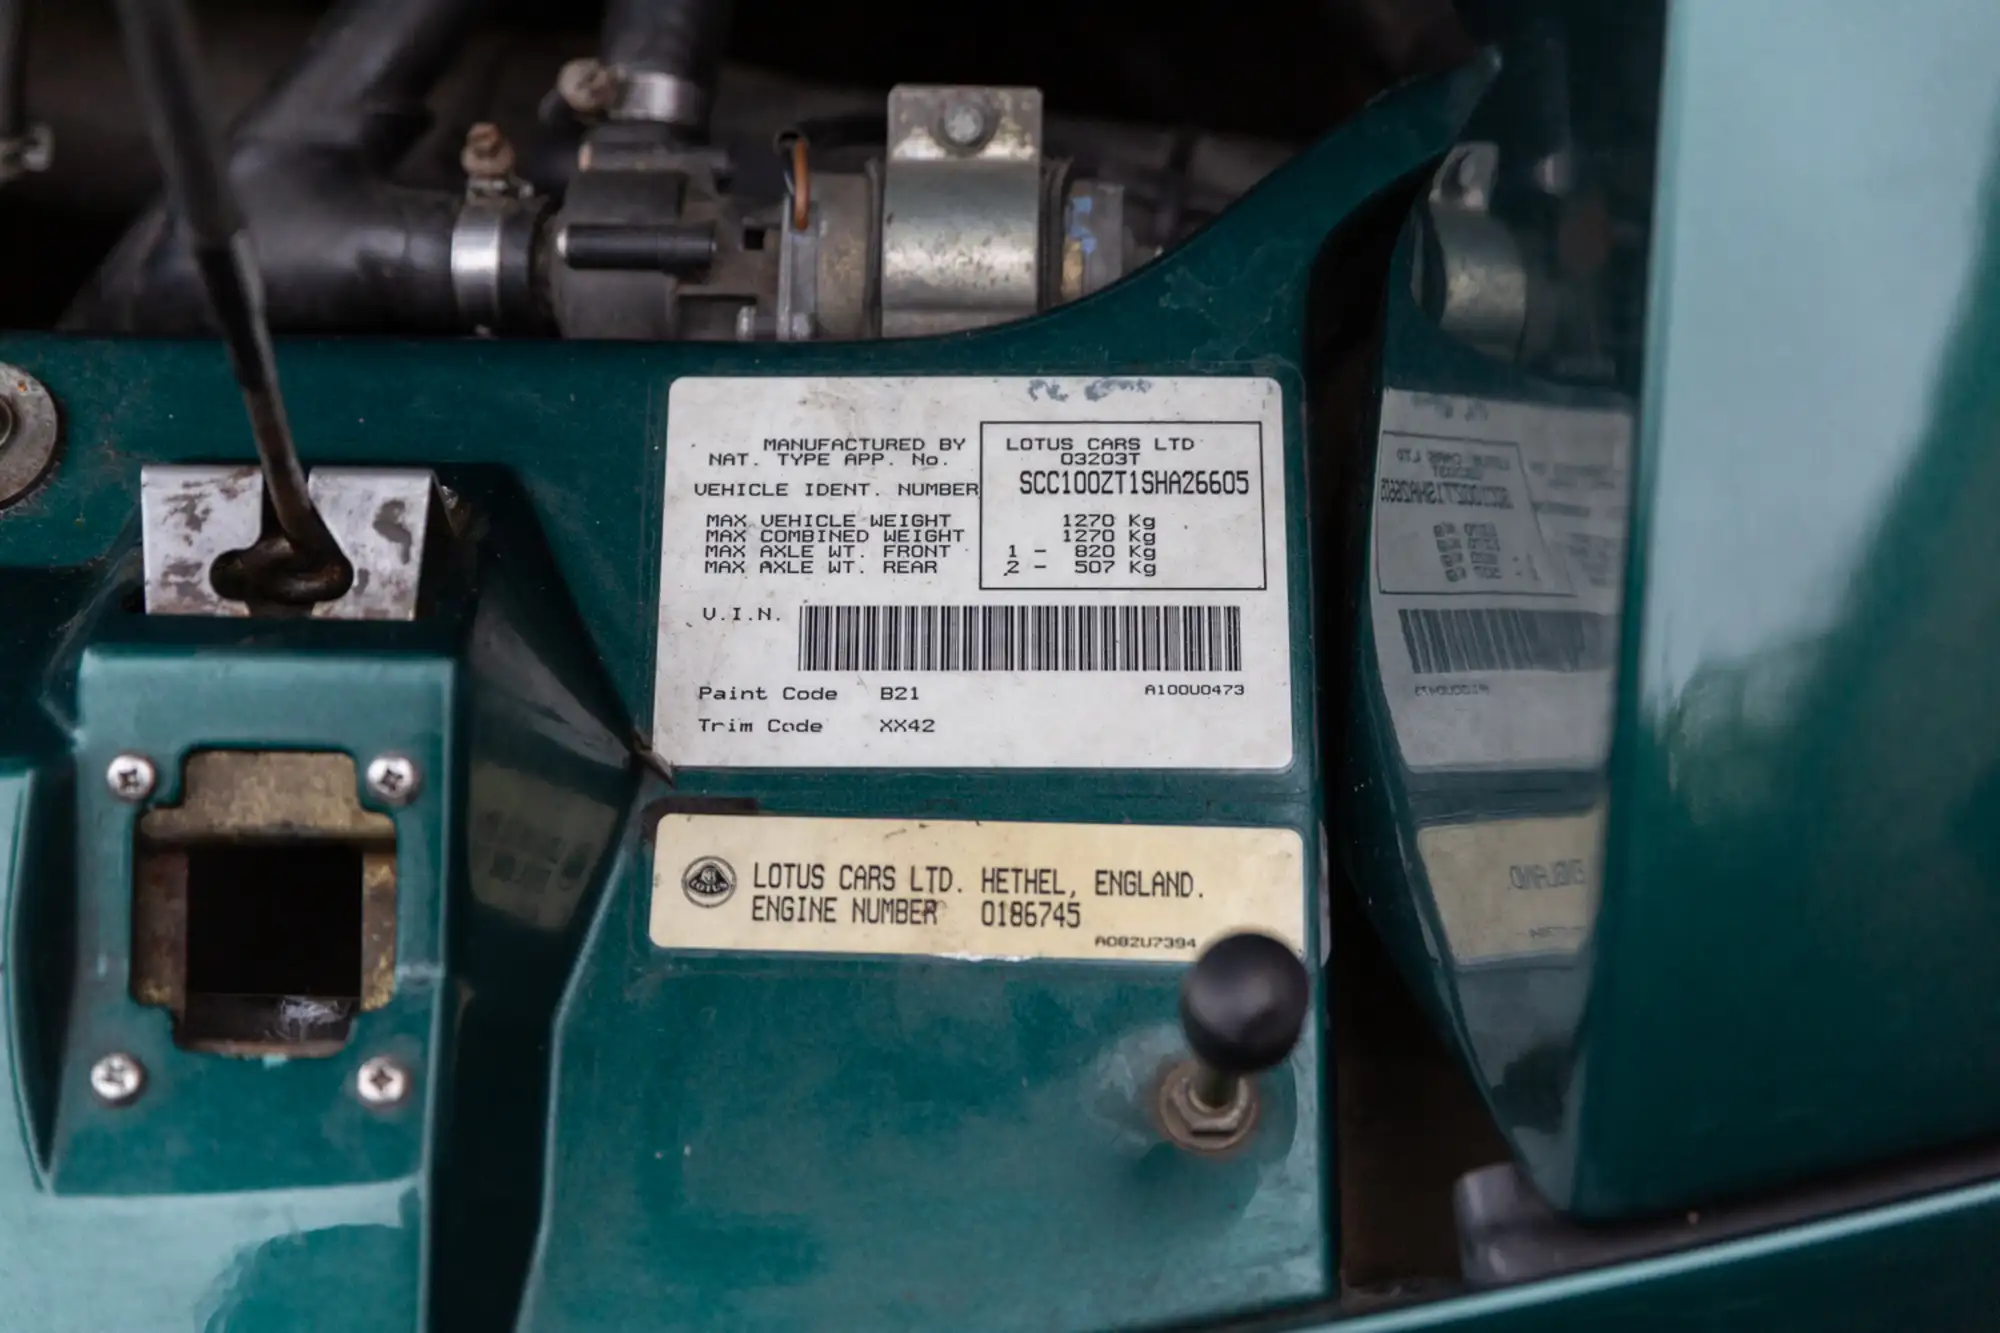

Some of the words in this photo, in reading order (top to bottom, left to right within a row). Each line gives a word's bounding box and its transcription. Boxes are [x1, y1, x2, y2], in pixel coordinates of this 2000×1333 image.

[763, 436, 926, 452] MANUFACTURED
[939, 437, 966, 452] BY
[1006, 437, 1074, 452] LOTUS
[1087, 437, 1141, 451] CARS
[1154, 437, 1195, 452] LTD
[708, 452, 759, 467] NAT.
[776, 452, 831, 467] TYPE
[844, 452, 894, 467] APP.
[911, 452, 948, 467] No.
[1060, 451, 1141, 467] 03203T
[693, 482, 789, 497] VEHICLE
[804, 482, 880, 497] IDENT.
[897, 482, 980, 497] NUMBER
[1019, 469, 1250, 496] SCC100ZT1SHA26605
[705, 513, 748, 528] MAX
[760, 513, 857, 528] VEHICLE
[869, 513, 952, 528] WEIGHT
[1063, 513, 1116, 528] 1270
[1128, 513, 1156, 531] Kg
[705, 528, 747, 544] MAX
[759, 528, 870, 544] COMBINED
[883, 528, 965, 544] WEIGHT
[1063, 528, 1116, 543] 1270
[1128, 528, 1156, 547] Kg
[704, 544, 746, 559] MAX
[759, 544, 815, 559] AXLE
[828, 544, 865, 559] WT.
[883, 544, 952, 559] FRONT
[1008, 544, 1017, 559] 1
[1074, 544, 1116, 559] 820
[1128, 543, 1157, 562] Kg
[704, 560, 746, 575] MAX
[759, 560, 814, 575] AXLE
[827, 560, 864, 575] WT.
[882, 559, 938, 575] REAR
[1005, 559, 1020, 576] 2
[1074, 559, 1116, 574] 507
[1129, 559, 1157, 578] Kg
[702, 606, 781, 622] V.I.N.
[697, 685, 768, 701] Paint
[782, 686, 838, 701] Code
[880, 686, 919, 701] B21
[1144, 684, 1245, 696] A100U0473
[697, 717, 754, 733] Trim
[767, 718, 824, 733] Code
[879, 718, 936, 733] XX42
[753, 861, 826, 891] LOTUS
[838, 863, 897, 892] CARS
[909, 865, 963, 895] LTD.
[981, 866, 1076, 899] HETHEL,
[1094, 868, 1204, 899] ENGLAND.
[751, 894, 838, 924] ENGINE
[851, 897, 940, 926] NUMBER
[981, 899, 1081, 929] 0186745
